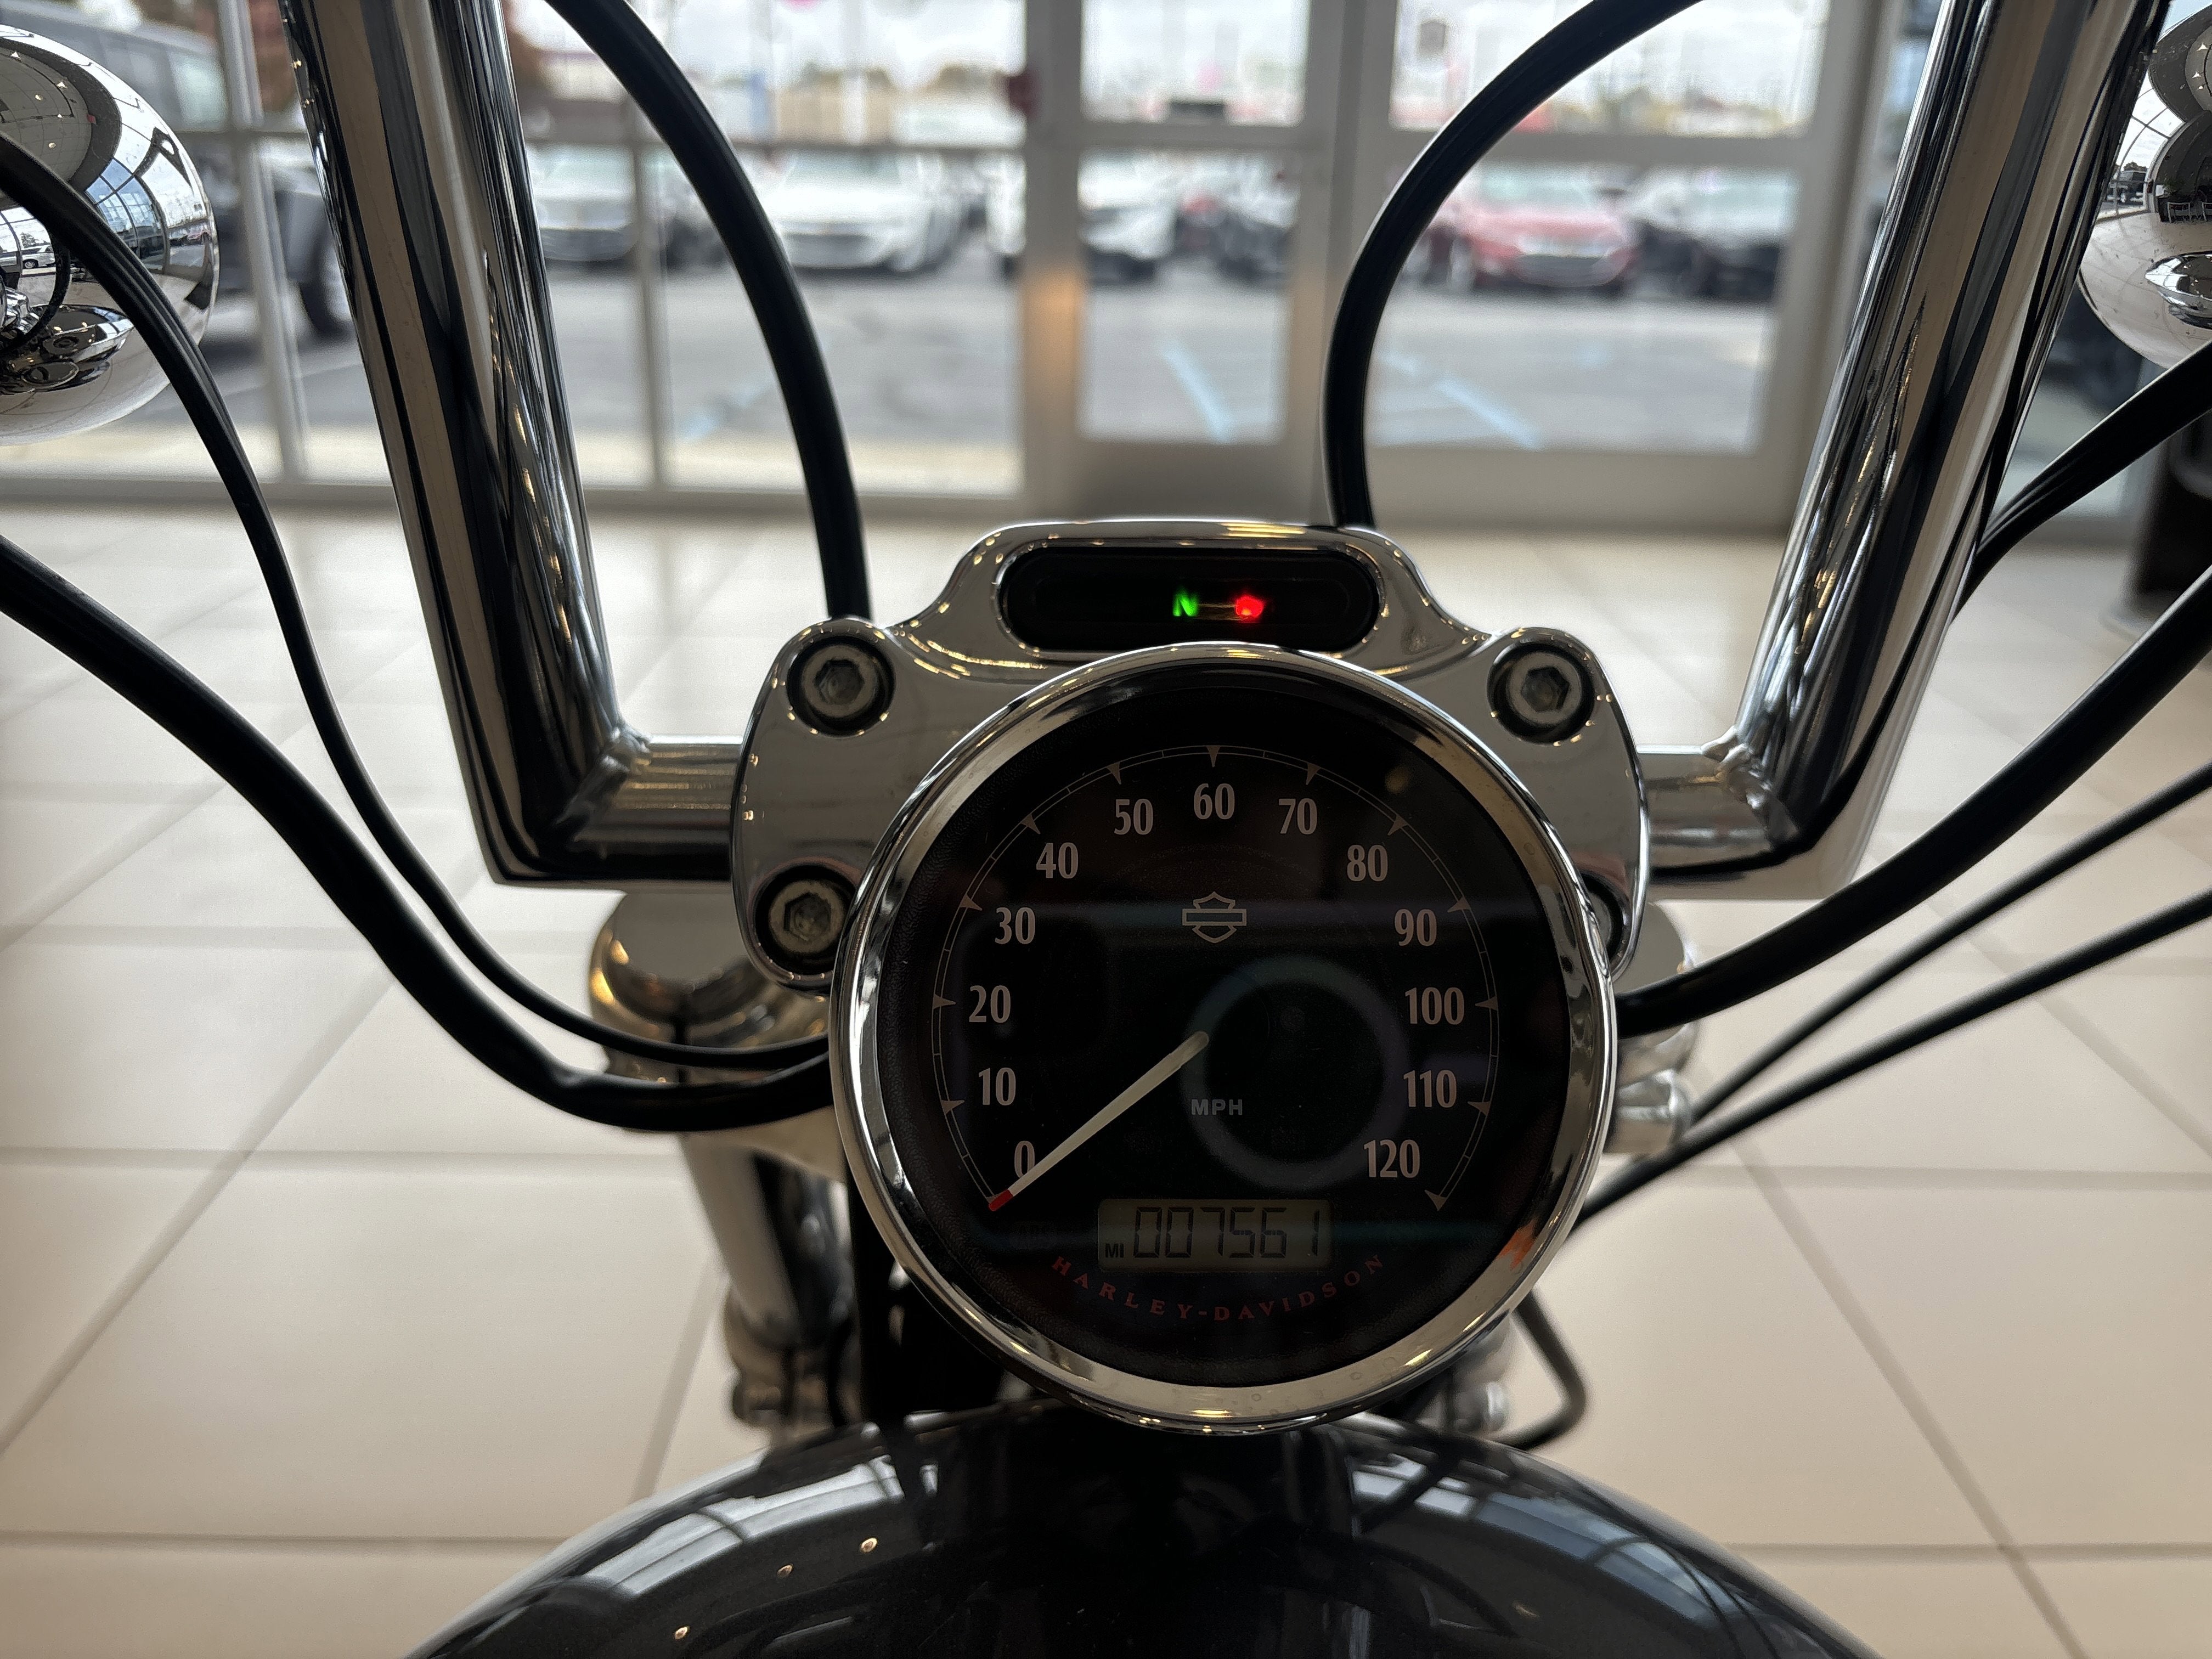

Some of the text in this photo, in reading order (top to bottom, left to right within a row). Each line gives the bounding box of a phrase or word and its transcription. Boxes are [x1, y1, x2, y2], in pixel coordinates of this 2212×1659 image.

[1113, 798, 1154, 836] 50
[1193, 783, 1235, 821] 60
[1278, 798, 1318, 836] 70
[1035, 841, 1080, 880] 40
[1346, 844, 1389, 883] 80
[994, 906, 1036, 945] 30
[1393, 907, 1438, 947] 90
[968, 984, 1012, 1024] 20
[1404, 987, 1465, 1025] 100
[978, 1066, 1017, 1107] 10
[1403, 1069, 1458, 1108] 110
[1191, 1099, 1243, 1116] MPH
[1014, 1140, 1036, 1180] 0
[1363, 1139, 1421, 1178] 120
[1104, 1206, 1321, 1259] MI 007561
[1050, 1255, 1384, 1321] HARLEY-DAVIDSON
